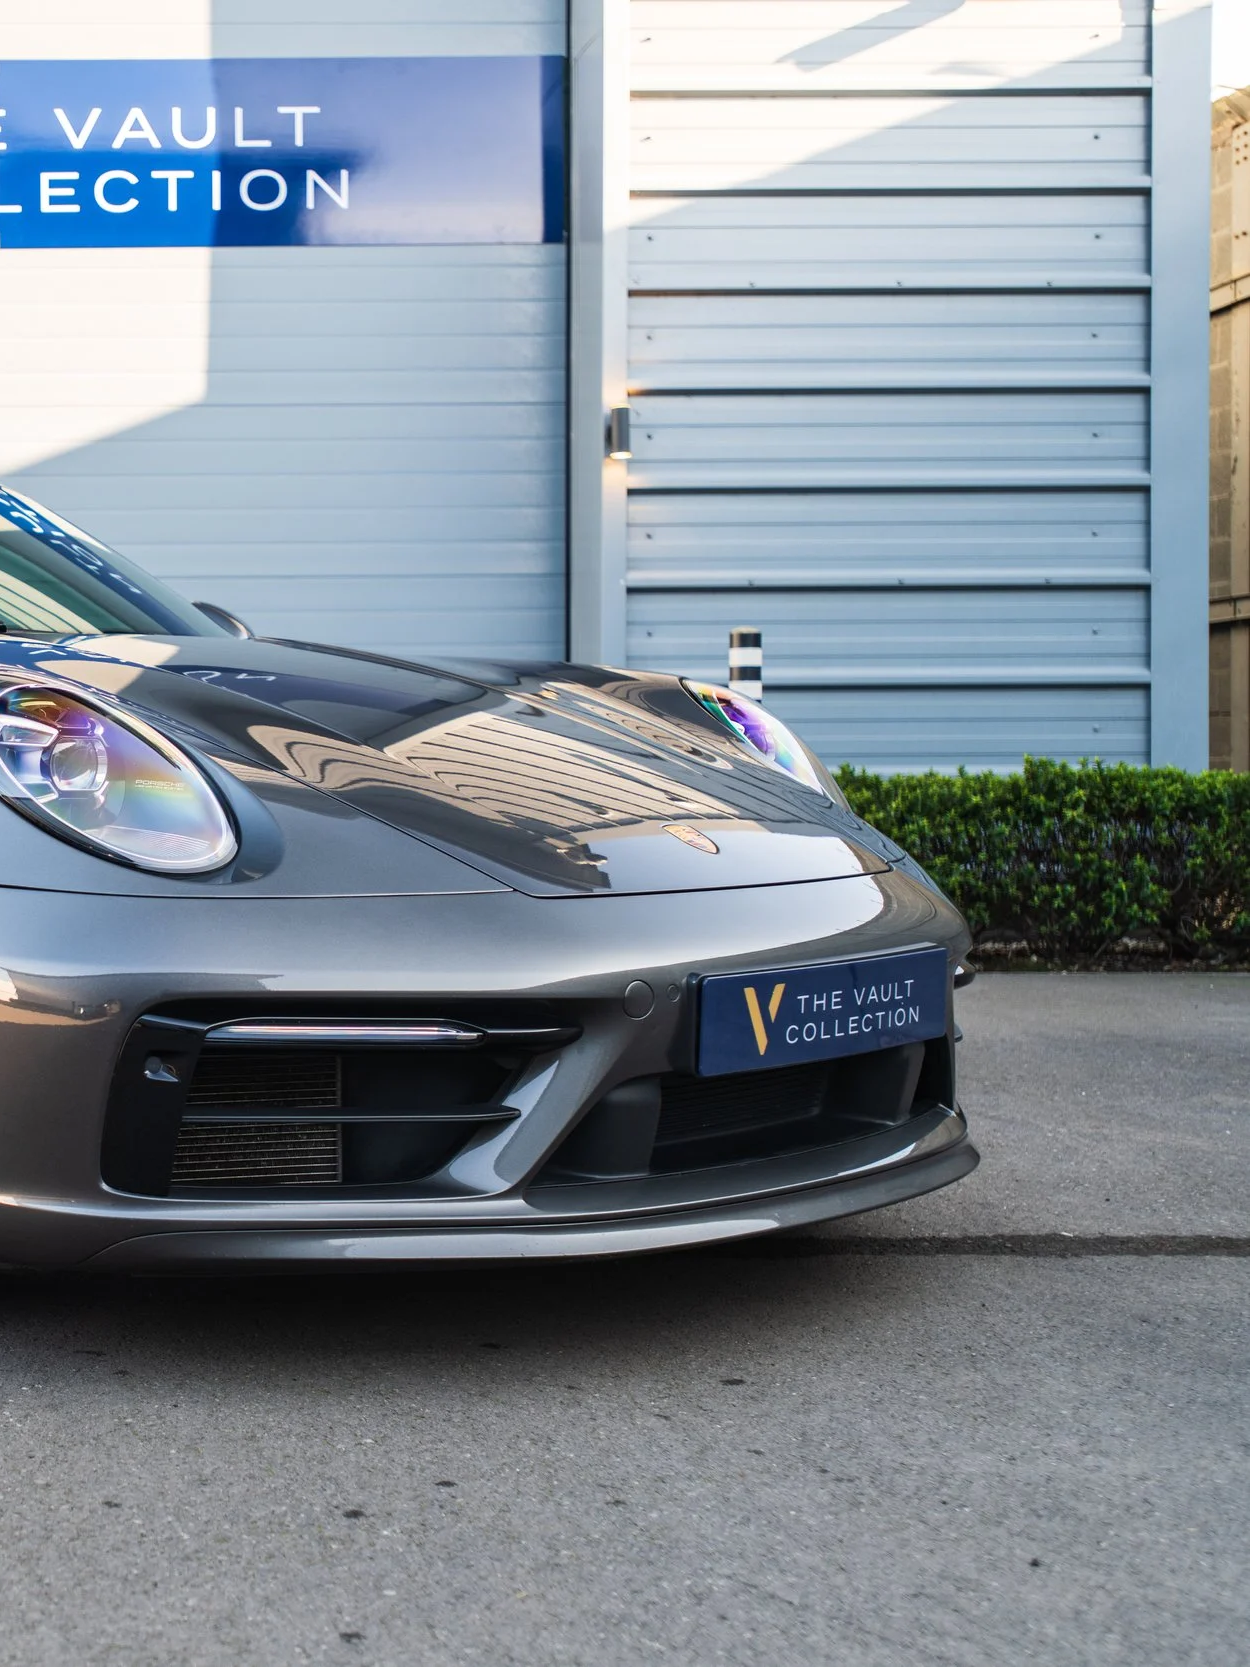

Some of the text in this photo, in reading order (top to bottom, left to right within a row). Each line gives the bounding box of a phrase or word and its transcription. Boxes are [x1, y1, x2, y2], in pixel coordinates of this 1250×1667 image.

[53, 106, 321, 149] VAULT
[797, 979, 915, 1014] THE VAULT
[786, 1005, 920, 1044] COLLECTION
